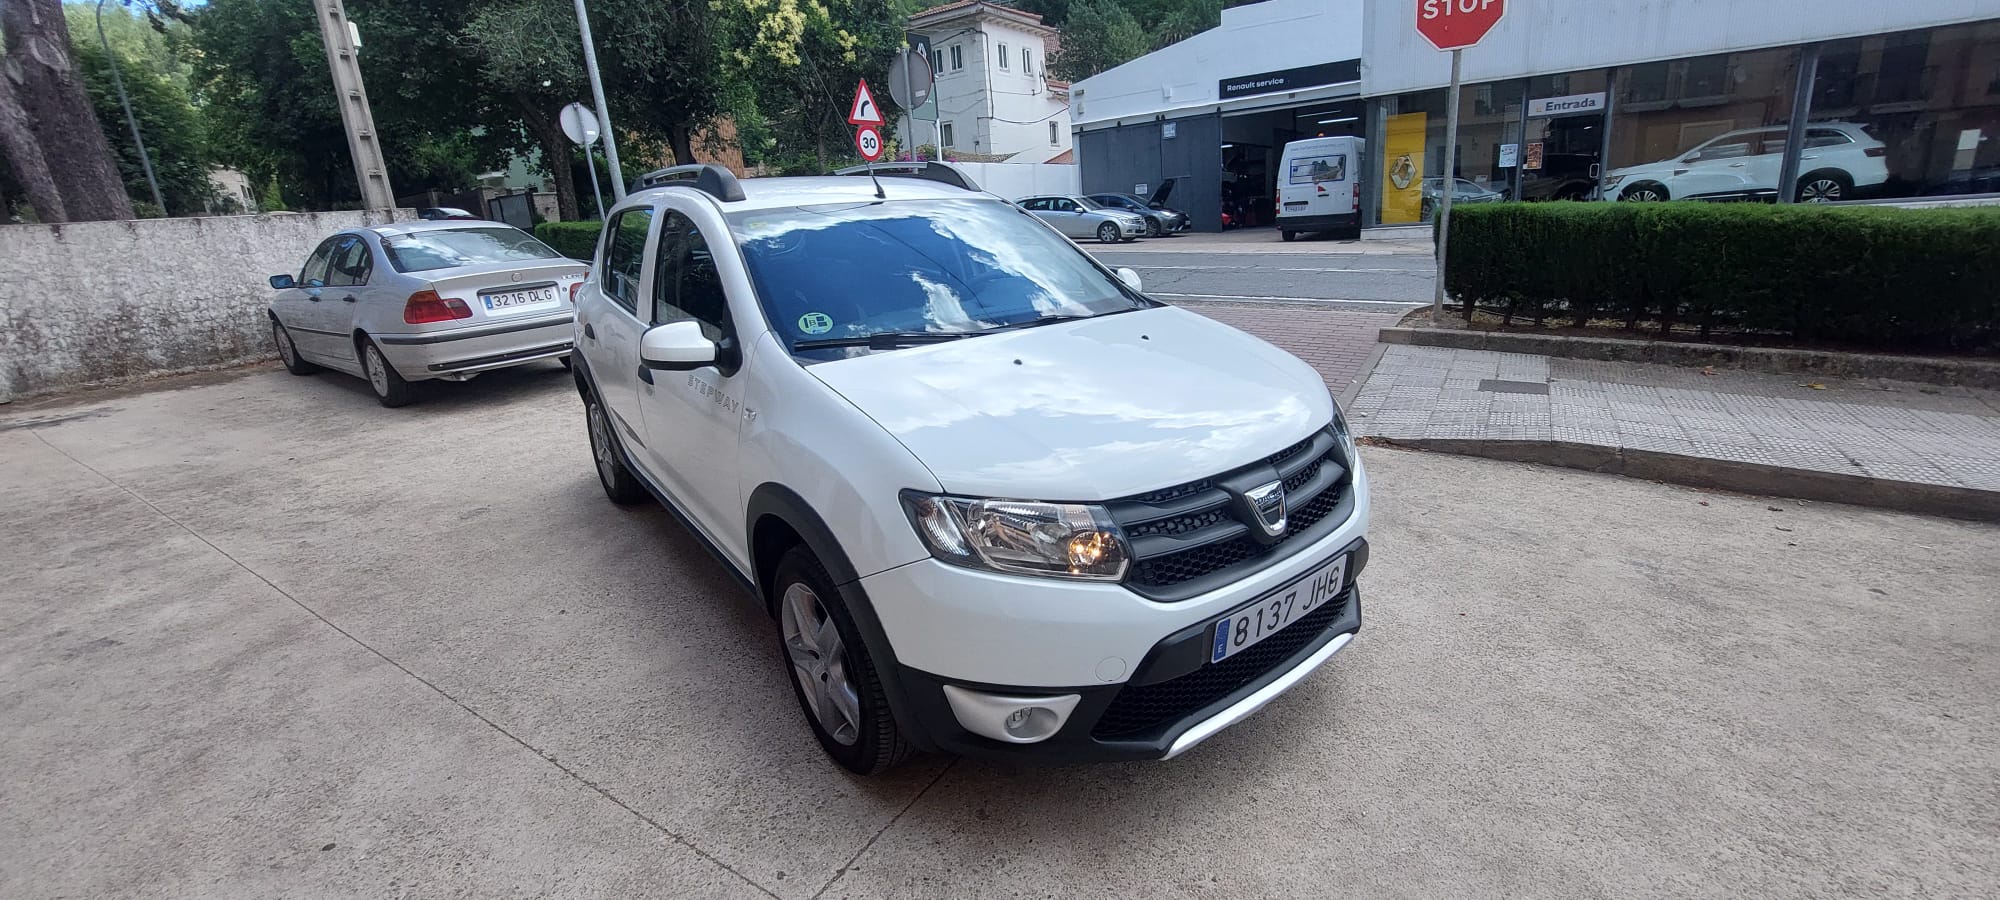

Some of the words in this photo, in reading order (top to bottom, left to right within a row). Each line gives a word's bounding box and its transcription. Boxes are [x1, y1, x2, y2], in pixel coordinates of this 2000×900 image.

[1227, 81, 1256, 92] Renault
[1256, 77, 1285, 88] service
[1545, 98, 1596, 112] Entrada
[862, 137, 877, 149] 30
[493, 293, 526, 307] 3216
[528, 289, 552, 303] DLG
[687, 374, 739, 414] STEPWAY
[1233, 591, 1297, 647] 8137
[1302, 566, 1340, 611] JHG
